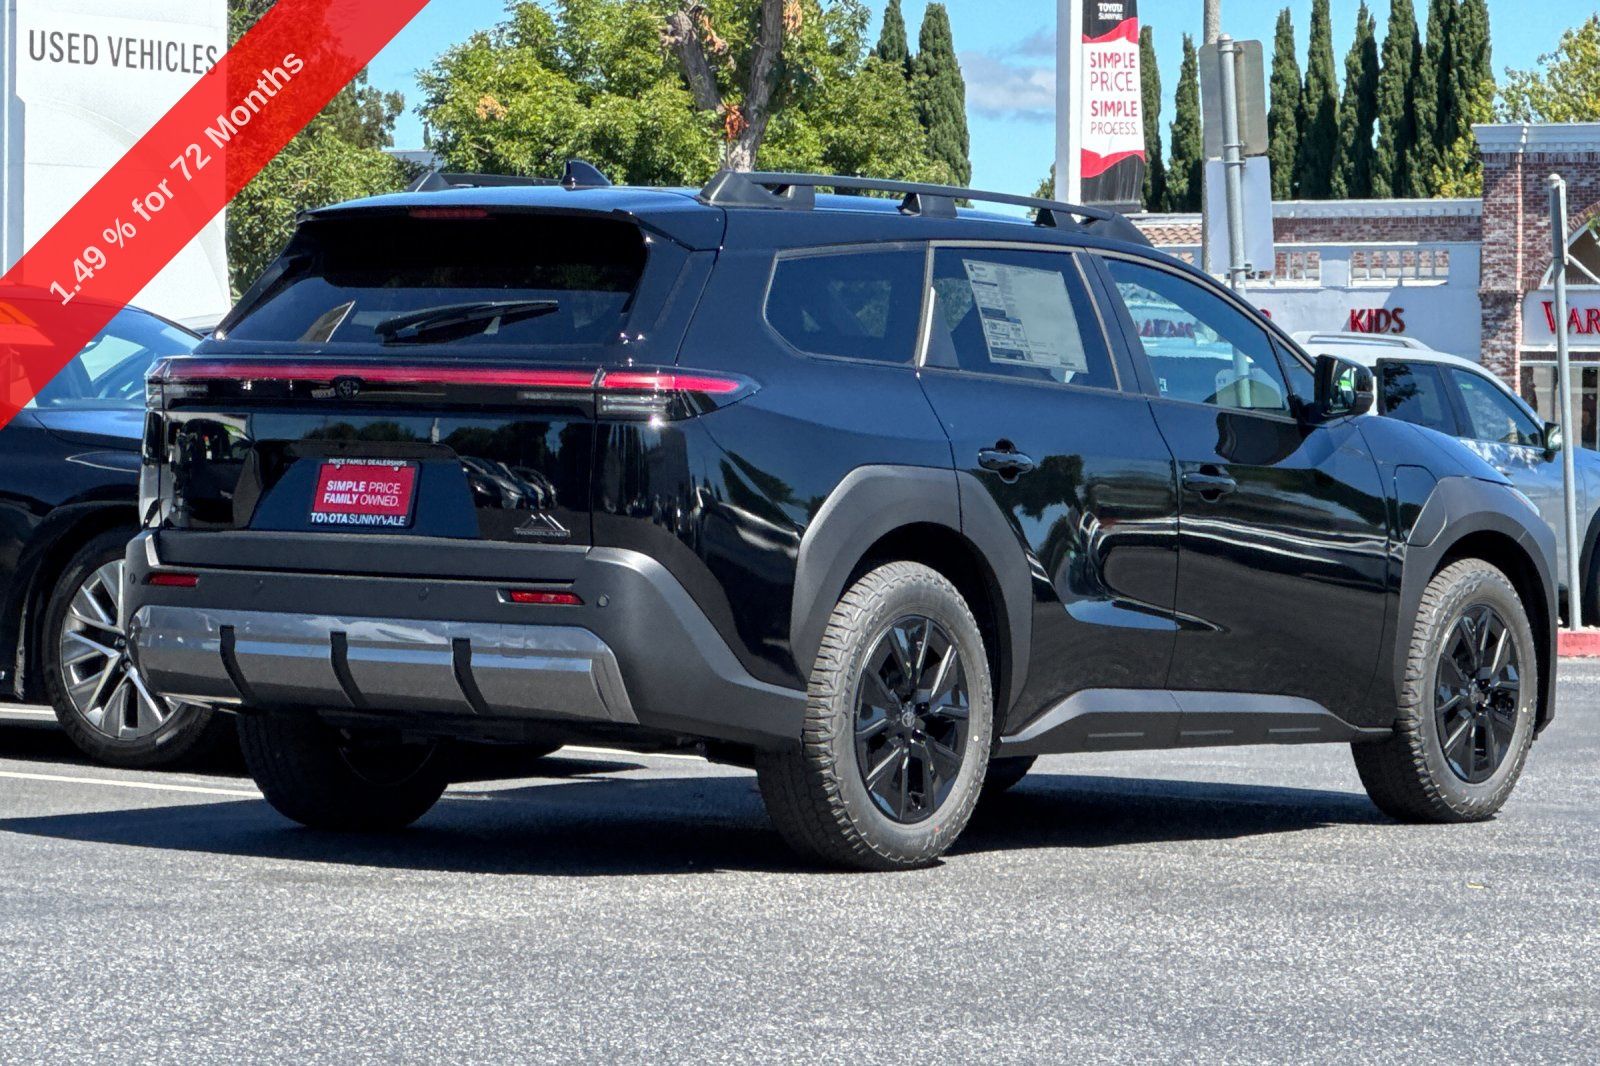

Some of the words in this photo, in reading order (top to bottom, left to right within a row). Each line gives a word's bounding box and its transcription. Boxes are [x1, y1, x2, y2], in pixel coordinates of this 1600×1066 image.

[29, 29, 99, 66] USED
[107, 35, 217, 75] VEHICLES
[1090, 52, 1136, 69] SIMPLE
[1091, 100, 1138, 117] SIMPLE
[1350, 308, 1406, 334] KIDS
[326, 480, 367, 493] SIMPLE
[368, 482, 402, 494] PRICE.
[323, 493, 360, 504] FAMILY
